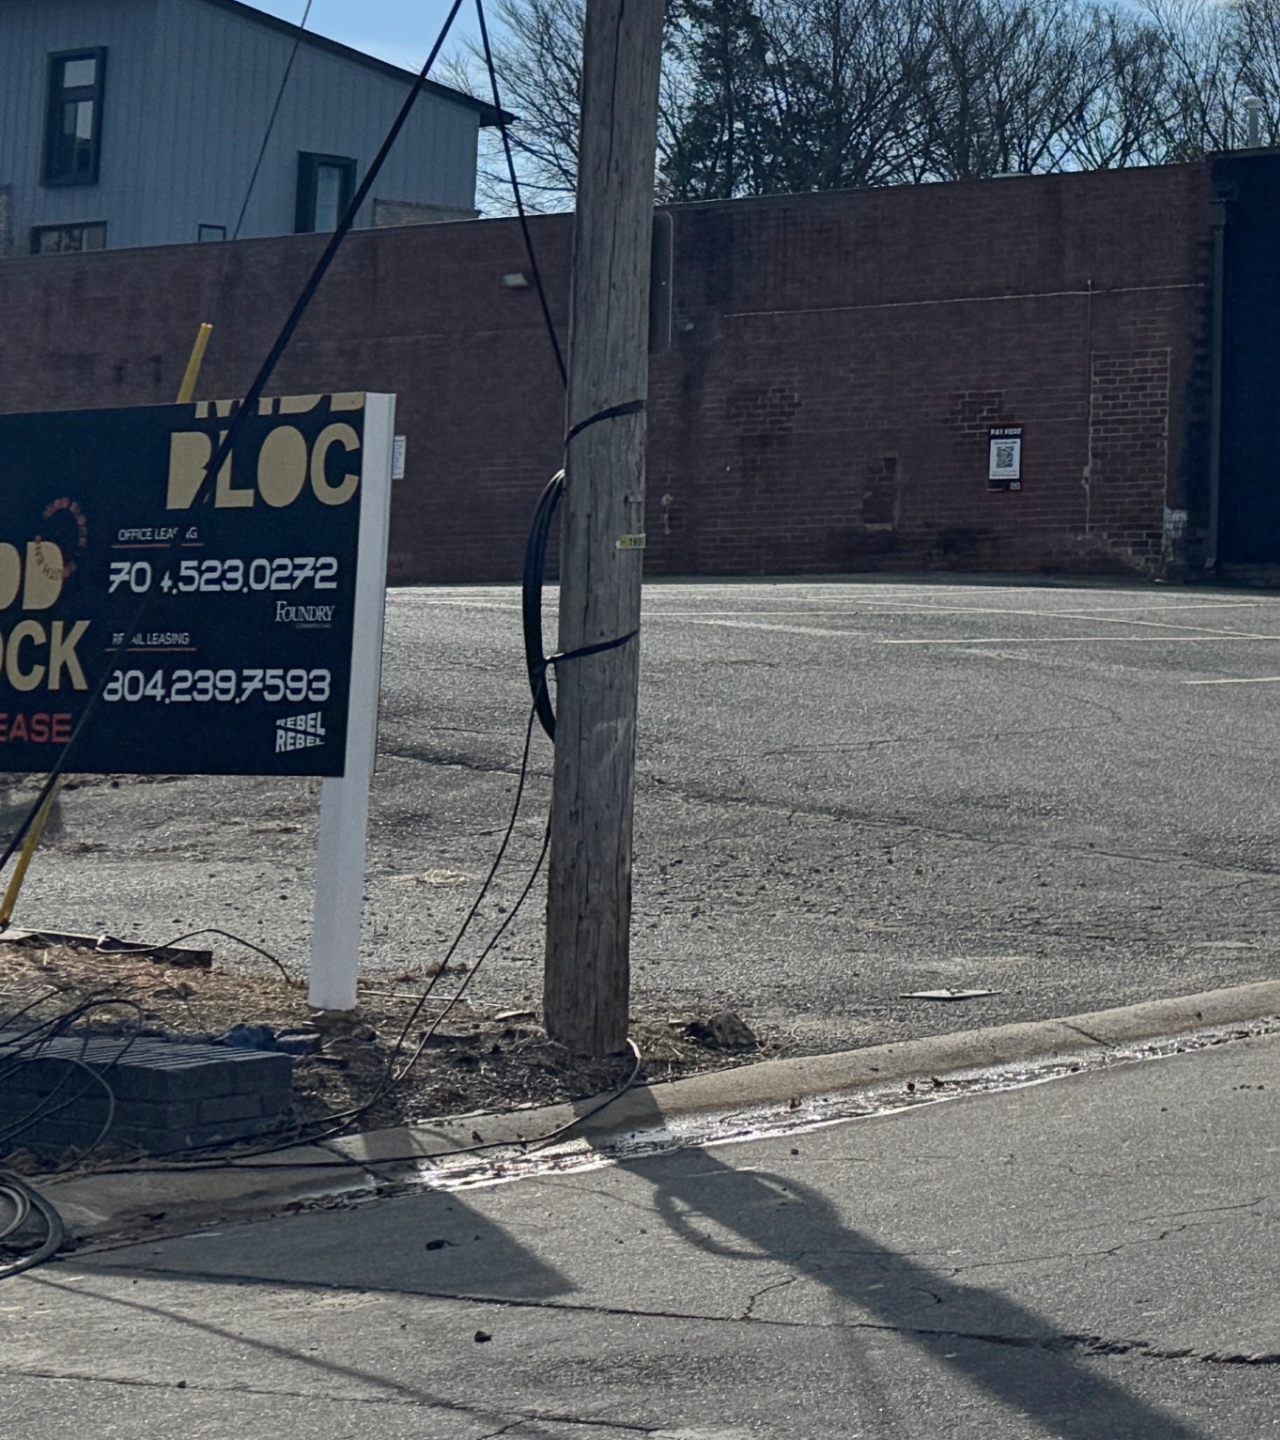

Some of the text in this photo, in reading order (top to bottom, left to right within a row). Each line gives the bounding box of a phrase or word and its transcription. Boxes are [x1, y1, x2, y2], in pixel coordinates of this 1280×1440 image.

[118, 527, 198, 541] OFFICE LEAG
[147, 633, 190, 645] LEASING
[275, 712, 326, 736] REBEL
[275, 729, 326, 753] REBEL
